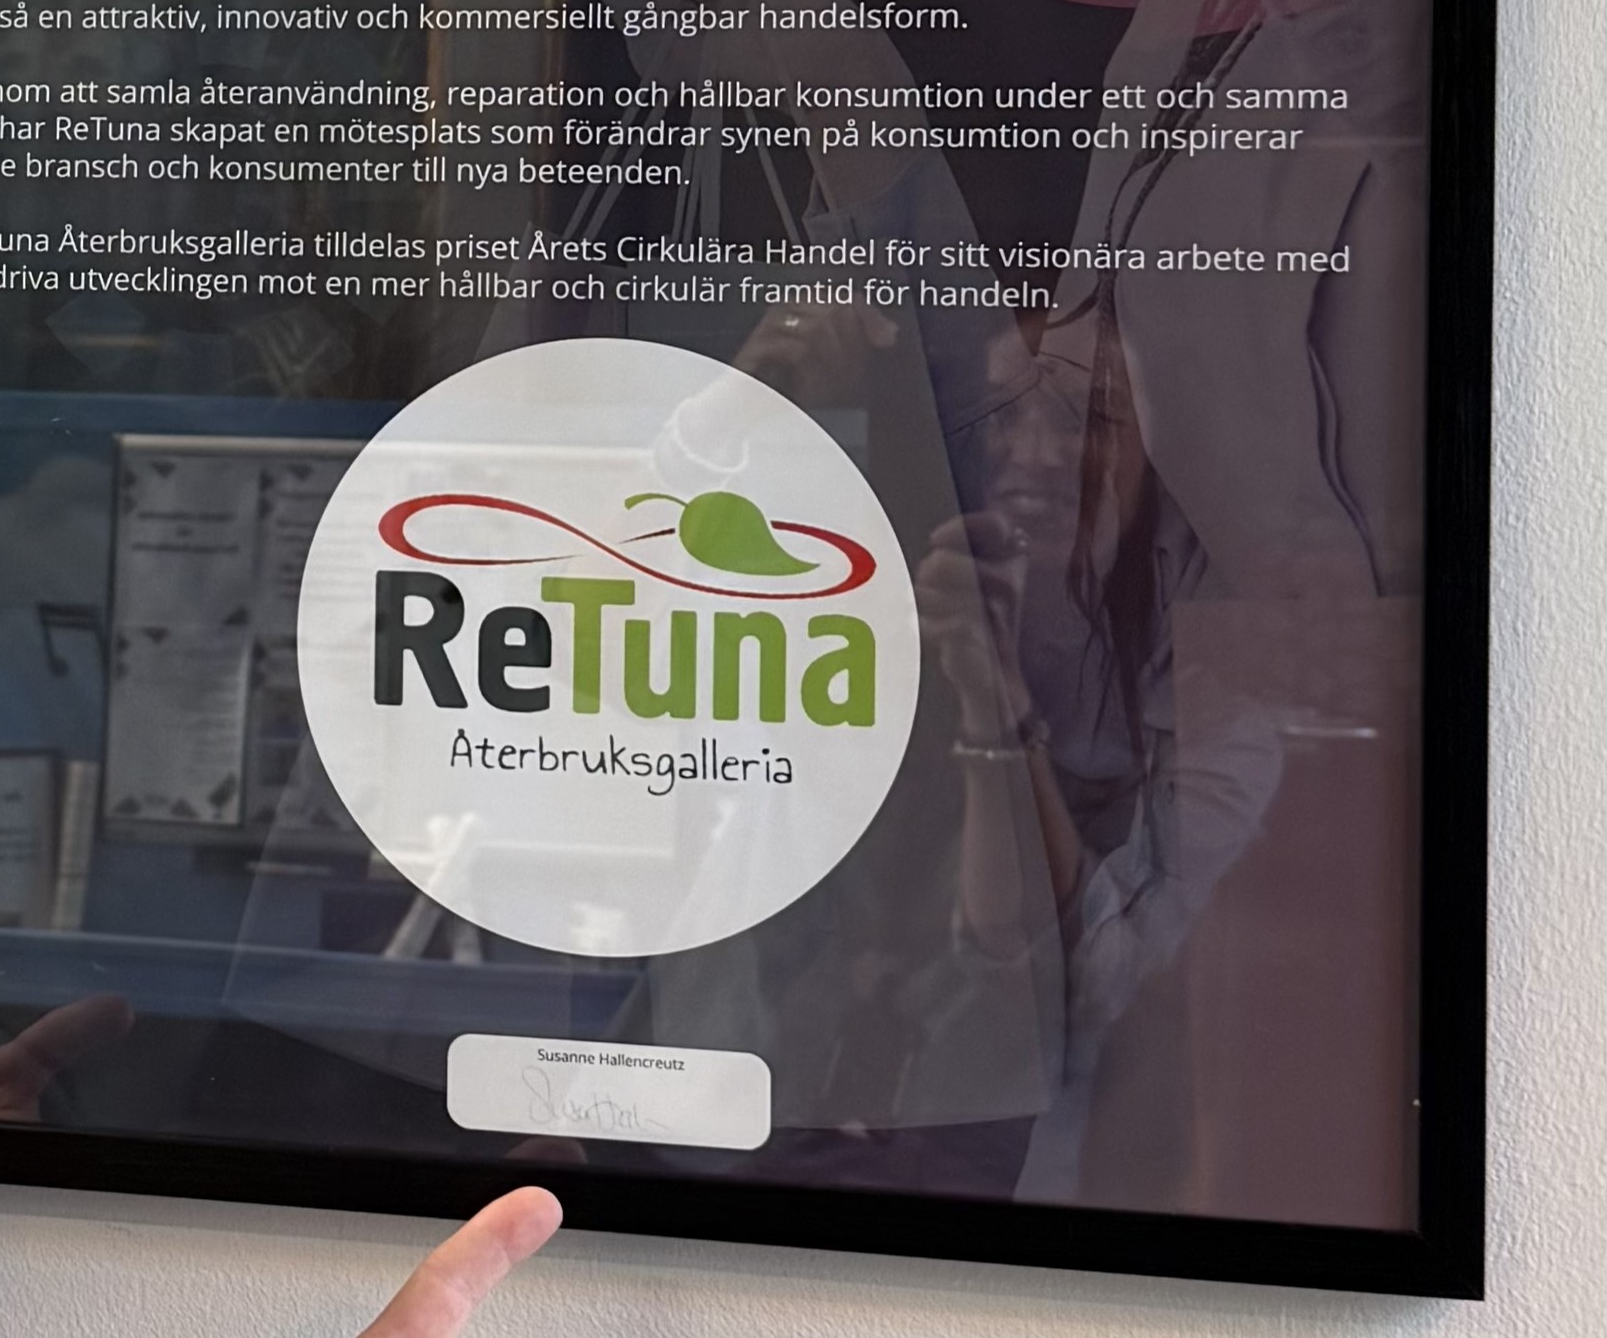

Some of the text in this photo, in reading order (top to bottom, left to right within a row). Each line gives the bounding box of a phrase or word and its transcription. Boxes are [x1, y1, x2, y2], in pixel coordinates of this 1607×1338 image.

[37, 8, 73, 30] en
[80, 1, 208, 35] attraktiv,
[216, 2, 350, 31] innovativ
[355, 1, 410, 31] och
[418, 1, 616, 31] kommersiellt
[621, 0, 752, 39] gångbar
[759, 0, 969, 31] handelsform.
[58, 79, 100, 105] att
[105, 76, 192, 106] samla
[198, 75, 438, 114] återanvändning,
[446, 79, 605, 115] reparation
[613, 79, 670, 109] och
[678, 77, 788, 109] hållbar
[795, 79, 985, 110] konsumtion
[994, 80, 1094, 110] under
[1100, 83, 1148, 110] ett
[1155, 81, 1216, 111] och
[1224, 87, 1349, 111] samma
[54, 114, 162, 143] ReTuna
[168, 115, 267, 151] skapat
[273, 122, 310, 144] en
[318, 116, 483, 153] mötesplats
[489, 123, 555, 146] som
[561, 117, 714, 148] förändrar
[719, 125, 812, 156] synen
[821, 116, 860, 156] på
[869, 119, 1062, 150] konsumtion
[1070, 120, 1130, 151] och
[1140, 121, 1305, 159] inspirerar
[25, 150, 140, 180] bransch
[147, 152, 200, 181] och
[208, 152, 406, 183] konsumenter
[410, 154, 447, 184] till
[455, 161, 509, 192] nya
[518, 155, 691, 187] beteenden.
[56, 222, 306, 264] Återbruksgalleria
[312, 229, 427, 260] tilldelas
[434, 232, 521, 268] priset
[526, 228, 608, 263] Årets
[615, 234, 755, 265] Cirkulära
[764, 236, 876, 267] Handel
[883, 237, 933, 268] för
[939, 239, 992, 269] sitt
[997, 239, 1147, 271] visionära
[1155, 241, 1267, 273] arbete
[1275, 243, 1351, 274] med
[68, 264, 249, 302] utvecklingen
[257, 270, 319, 297] mot
[324, 275, 362, 297] en
[370, 275, 432, 298] mer
[439, 268, 544, 300] hållbar
[550, 272, 606, 302] och
[614, 273, 733, 304] cirkulär
[737, 274, 854, 306] framtid
[862, 276, 912, 307] för
[919, 277, 1060, 310] handeln.
[373, 569, 877, 727] ReTuna
[449, 728, 794, 796] Återbruksgalleria
[536, 1047, 686, 1072] Susanne Hallencreutz
